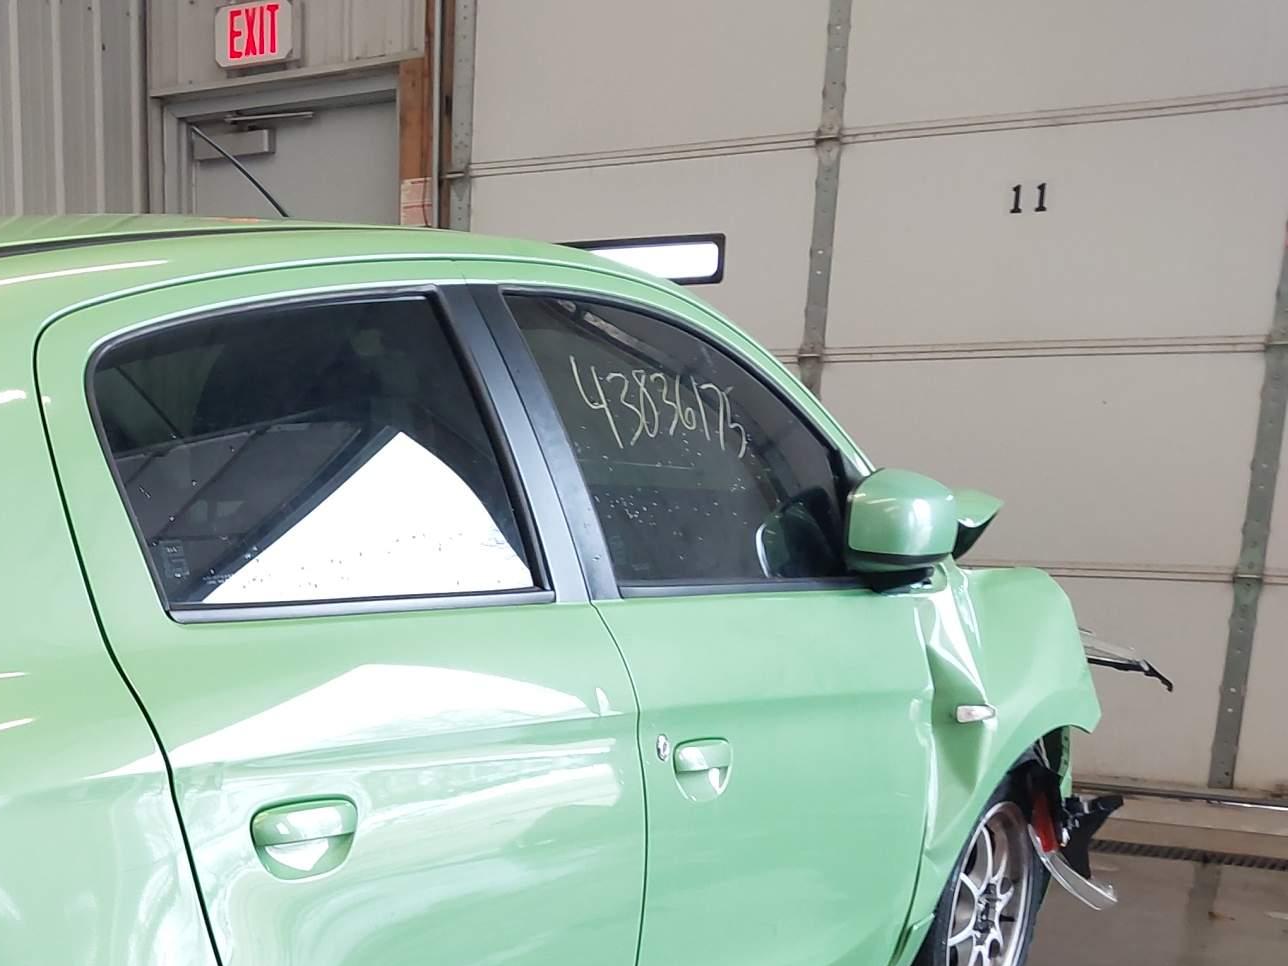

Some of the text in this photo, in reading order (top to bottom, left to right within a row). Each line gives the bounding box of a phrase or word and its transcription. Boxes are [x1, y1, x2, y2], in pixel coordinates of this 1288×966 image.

[229, 4, 280, 59] EXIT
[1009, 182, 1047, 214] 11
[570, 355, 747, 458] 43836175
